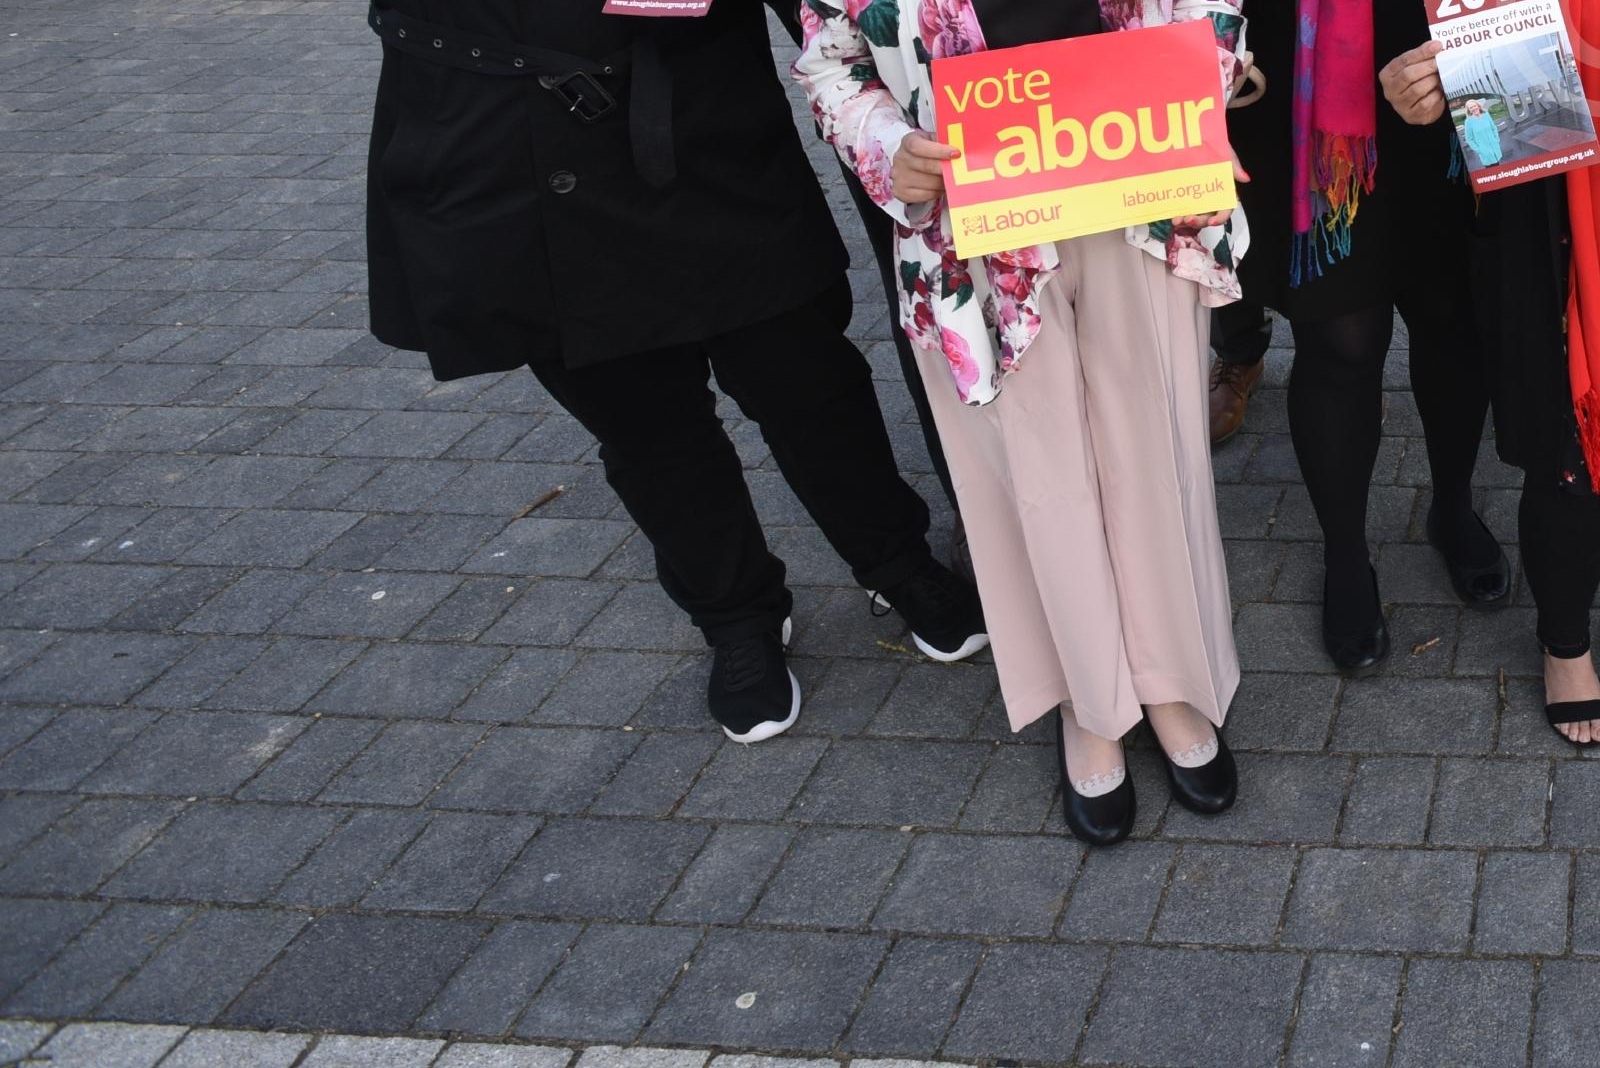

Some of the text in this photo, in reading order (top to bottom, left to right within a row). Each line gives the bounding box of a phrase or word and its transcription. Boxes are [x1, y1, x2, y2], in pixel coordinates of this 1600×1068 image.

[1436, 25, 1465, 38] You're
[1468, 16, 1500, 30] better
[1503, 11, 1518, 21] off
[1519, 4, 1542, 17] with
[1440, 14, 1556, 51] ABOUR COUNCIL
[944, 68, 1050, 113] vote
[947, 96, 1214, 185] Labour
[1123, 178, 1224, 207] labour.org.uk
[982, 204, 1062, 232] Labour
